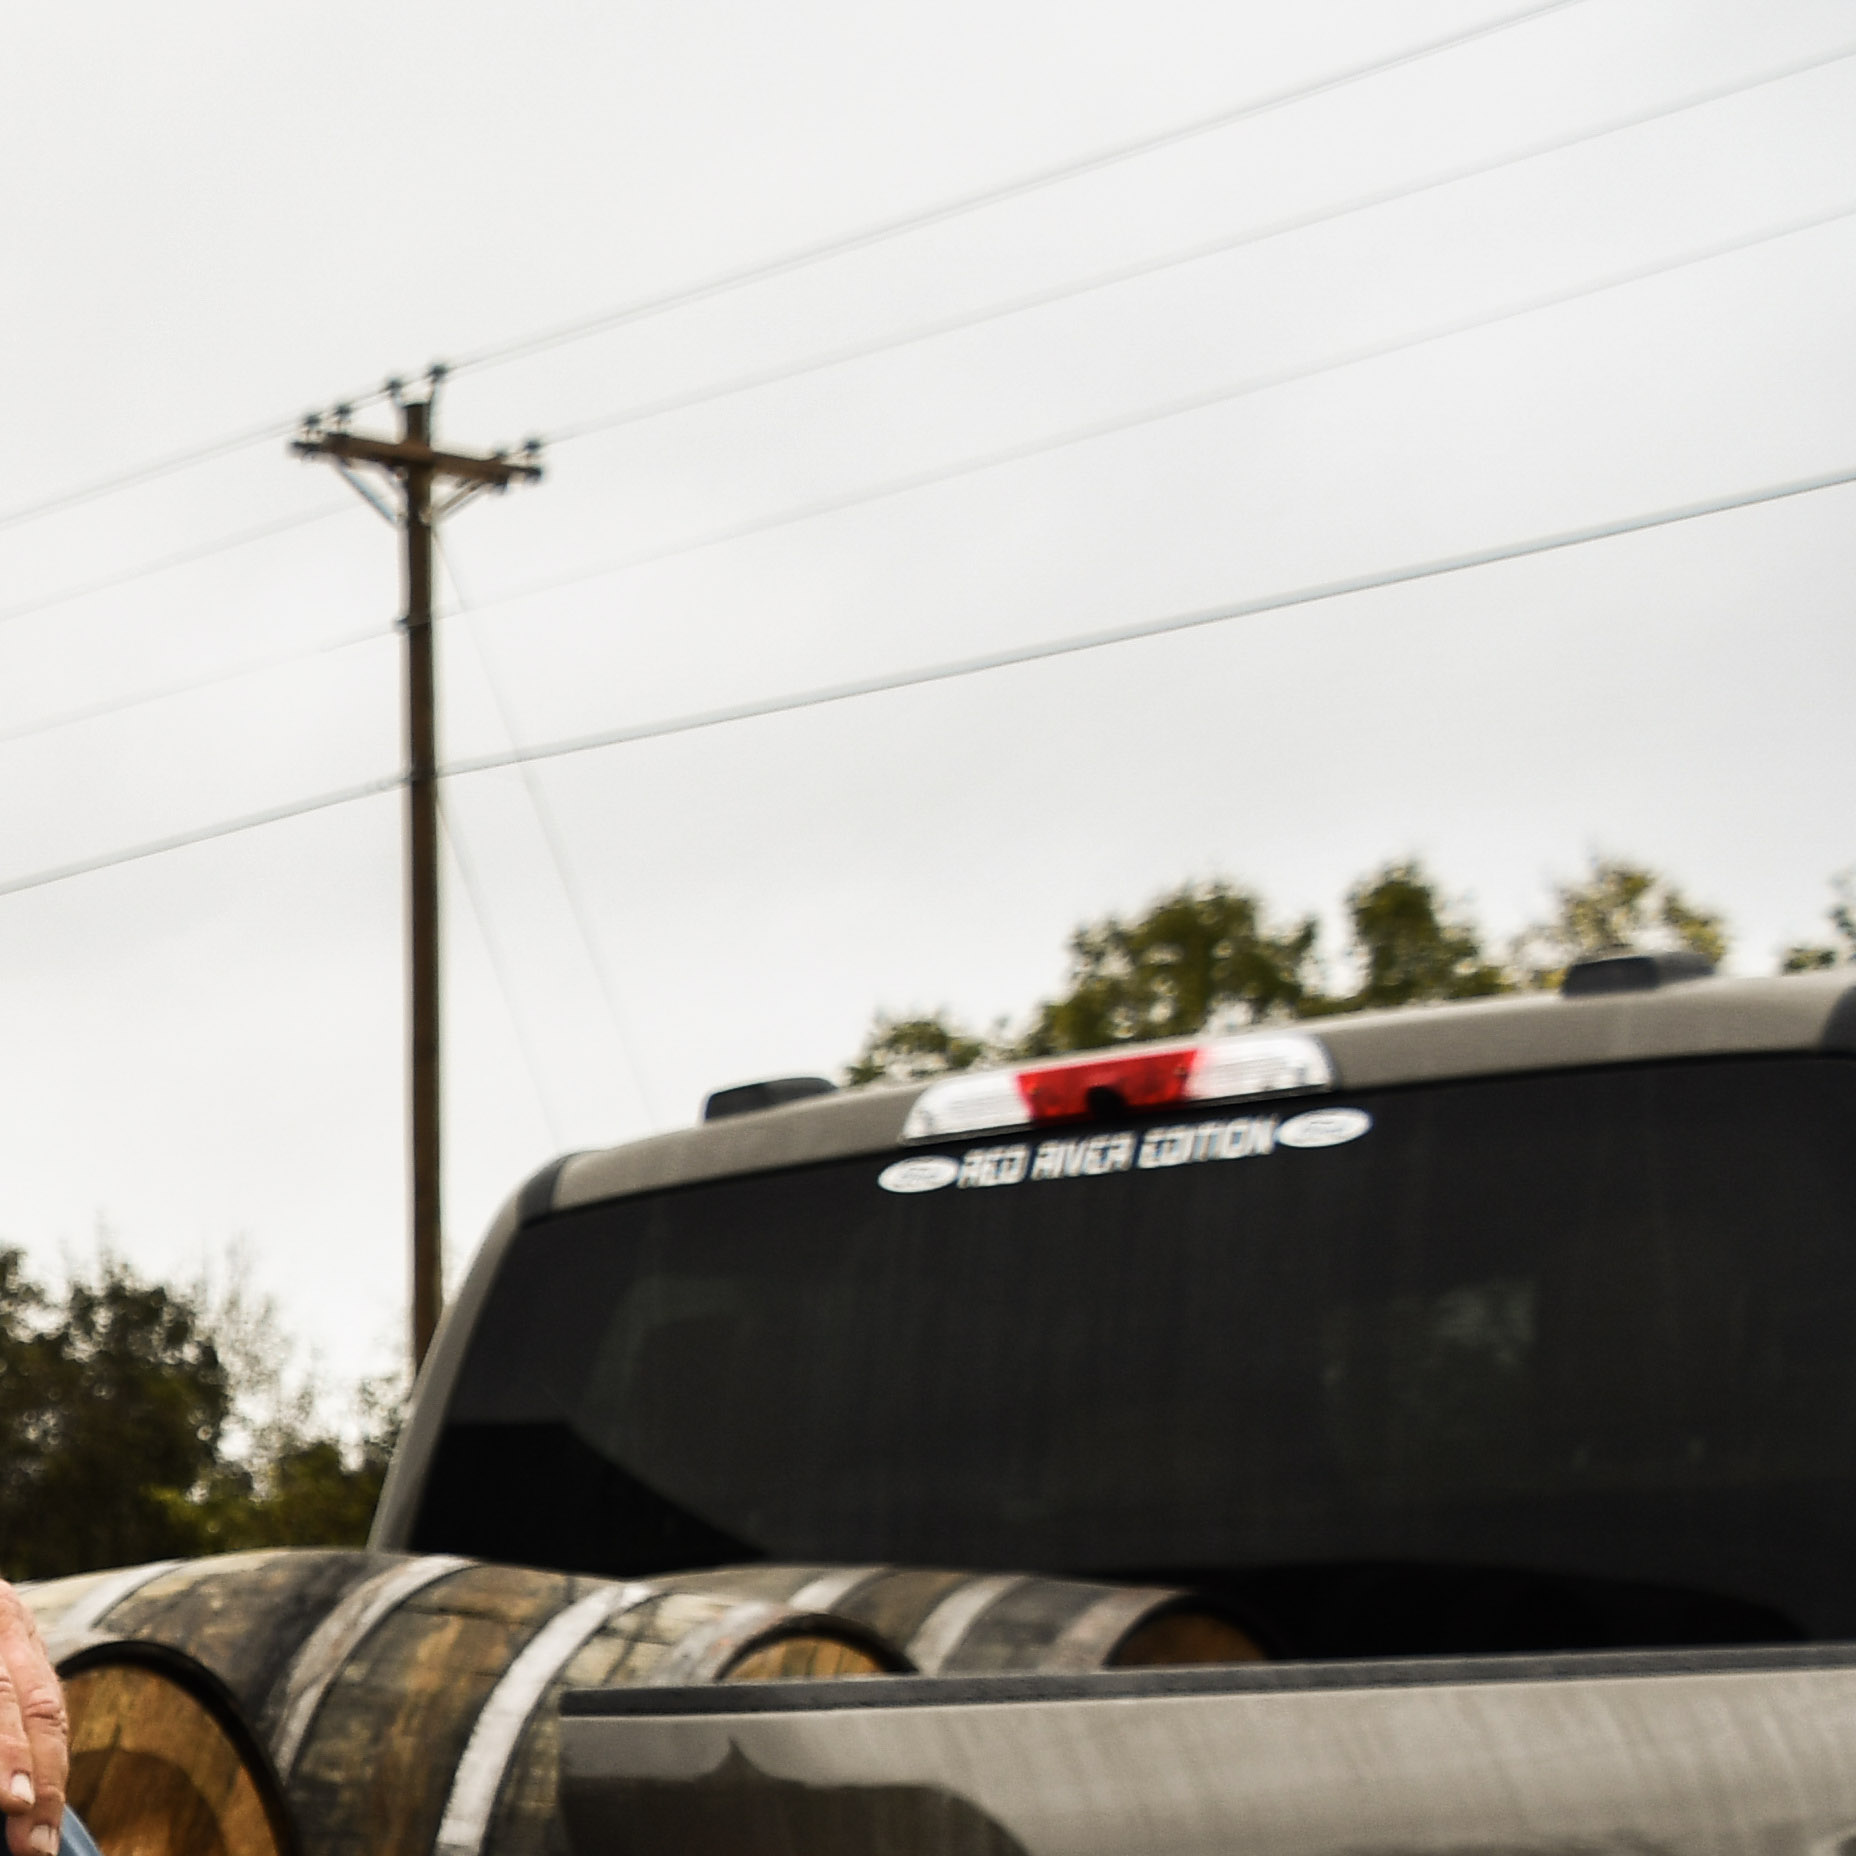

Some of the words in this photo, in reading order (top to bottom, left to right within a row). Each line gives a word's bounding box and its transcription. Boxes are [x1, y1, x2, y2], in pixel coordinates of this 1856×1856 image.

[956, 1143, 1031, 1189] RED
[1030, 1129, 1137, 1181] RIVER
[1137, 1113, 1281, 1169] EDITION
